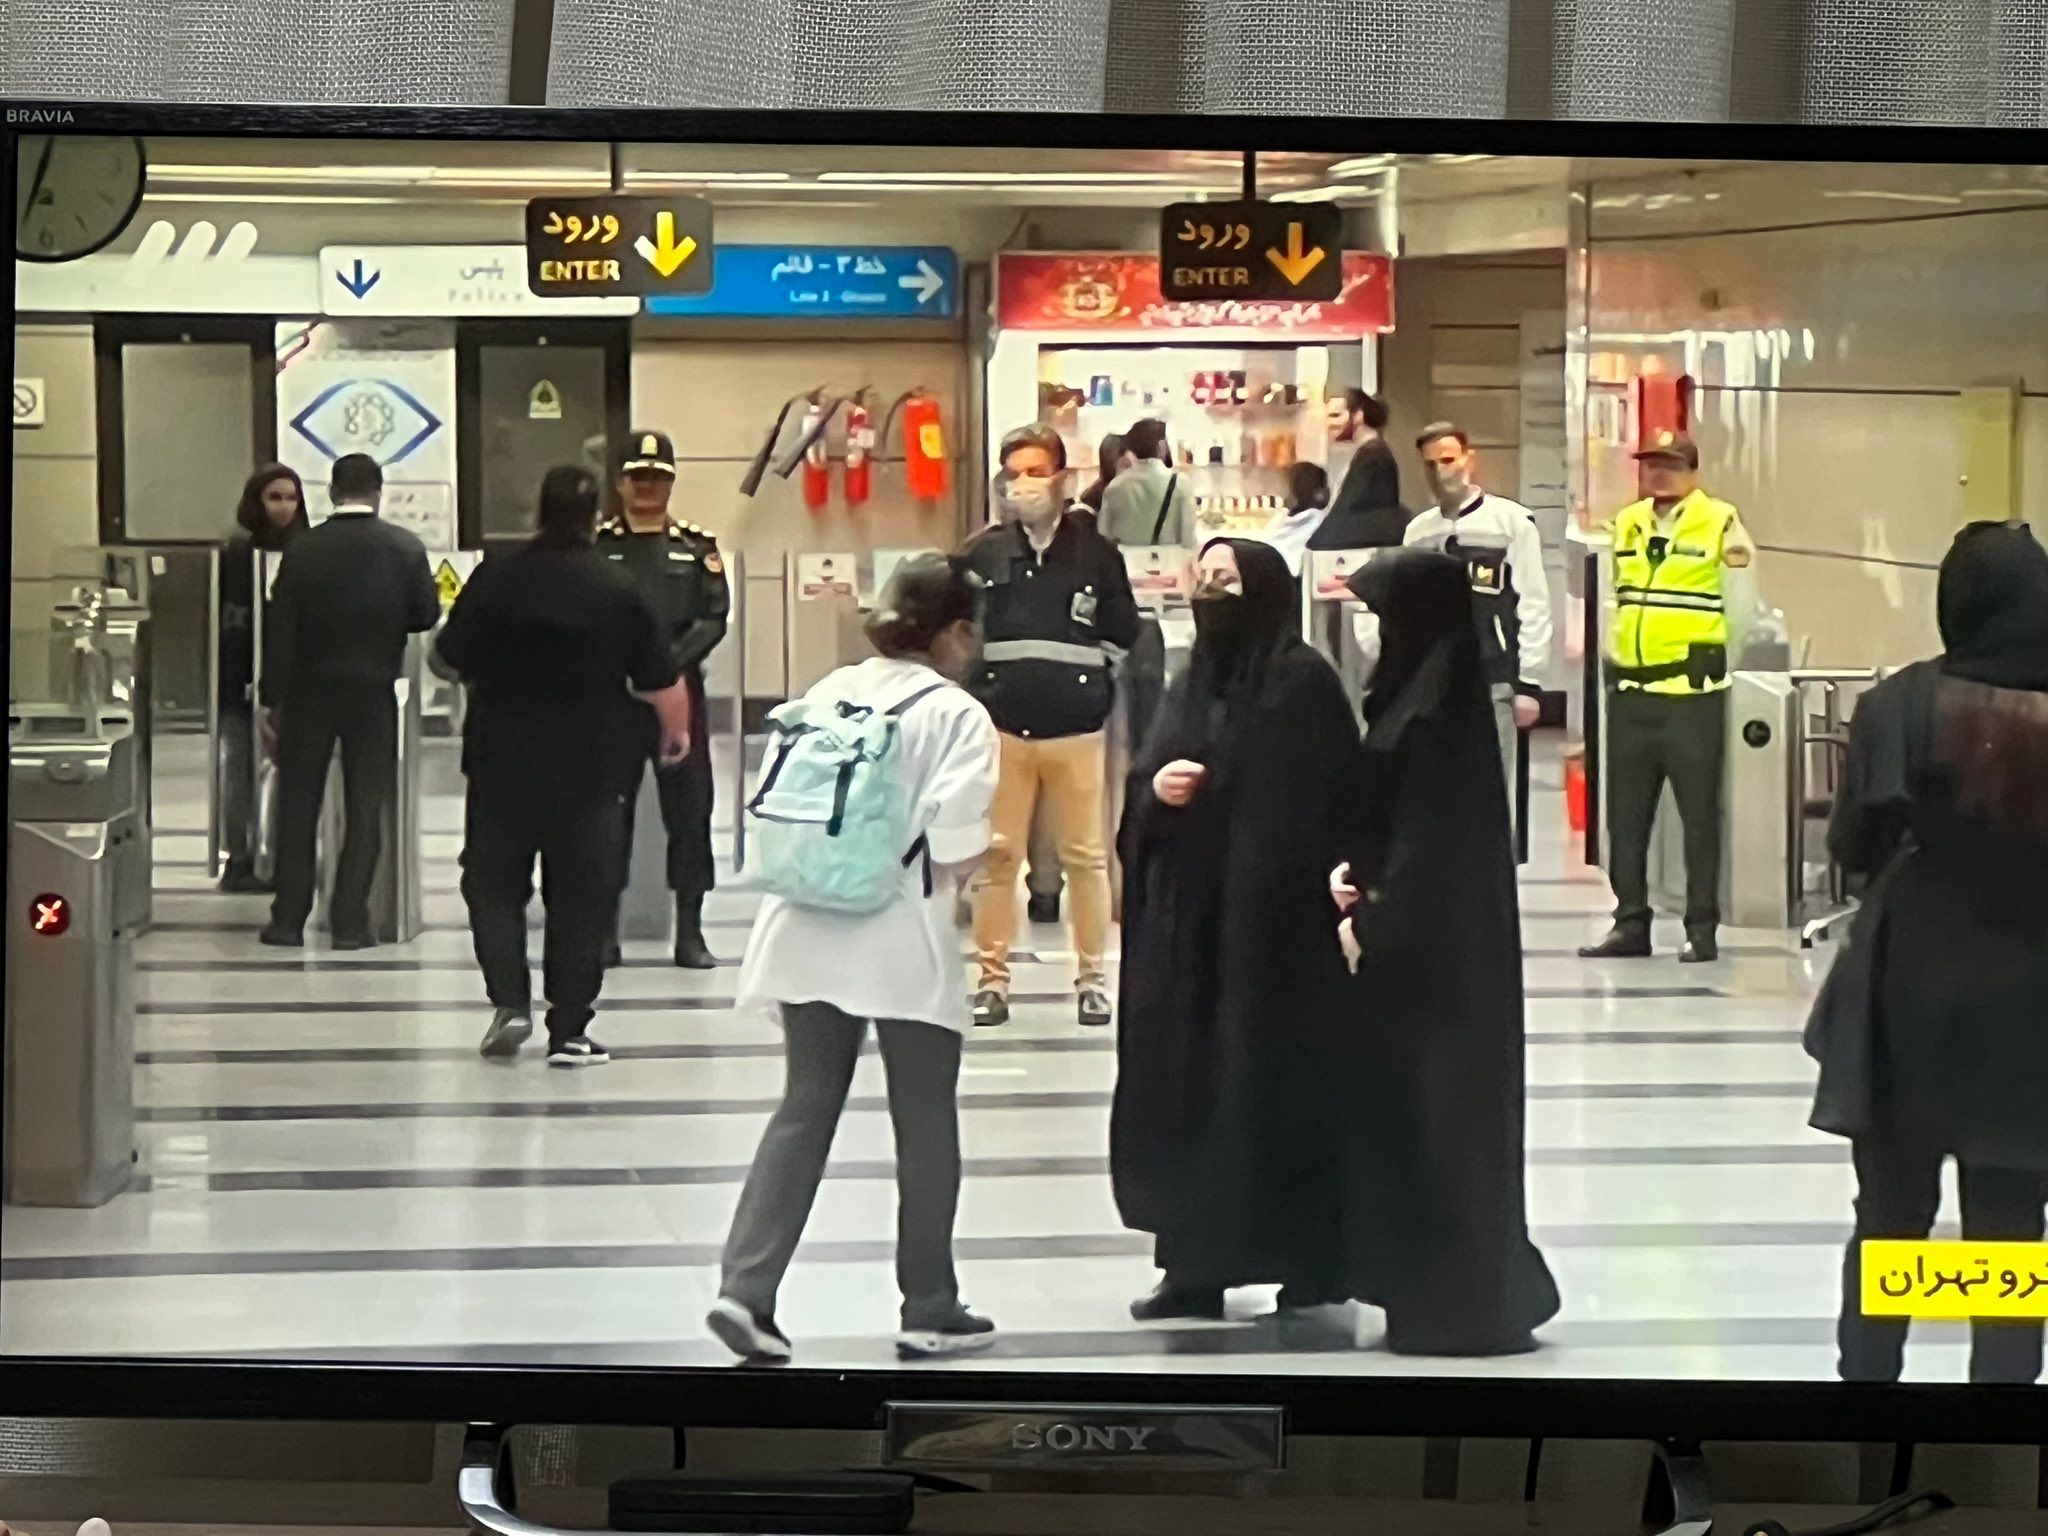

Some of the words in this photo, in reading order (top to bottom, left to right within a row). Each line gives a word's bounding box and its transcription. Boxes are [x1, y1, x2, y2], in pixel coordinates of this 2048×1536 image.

[6, 109, 75, 123] BRAVIA
[543, 211, 620, 244] ورود
[1177, 219, 1250, 250] ورود
[540, 259, 621, 281] ENTER
[1172, 266, 1250, 286] ENTER
[1879, 1254, 1990, 1298] تهران
[1011, 1423, 1157, 1451] SONY
